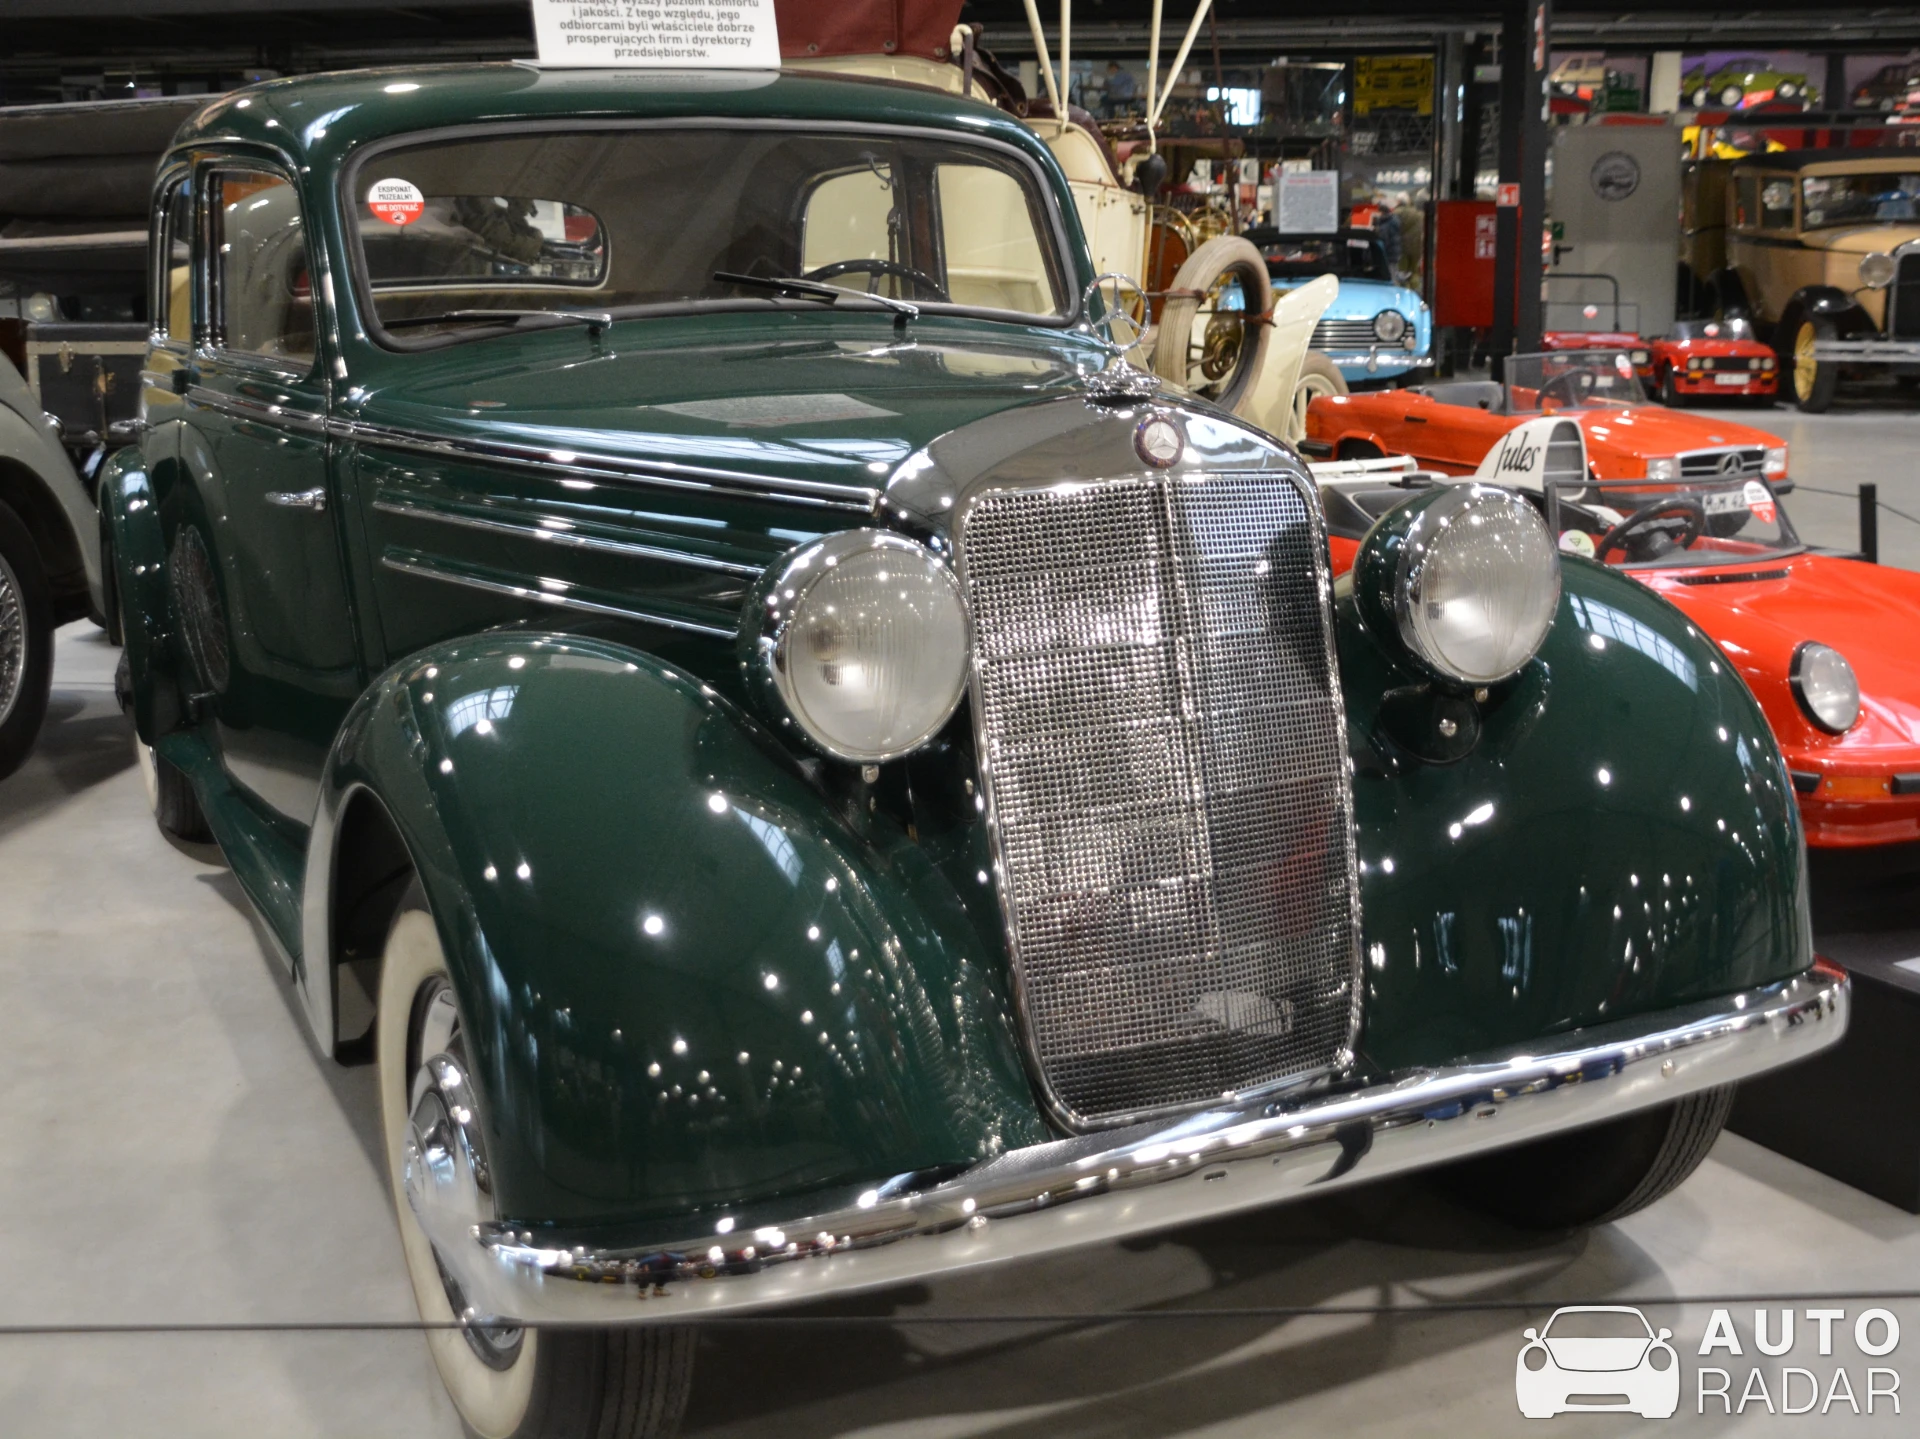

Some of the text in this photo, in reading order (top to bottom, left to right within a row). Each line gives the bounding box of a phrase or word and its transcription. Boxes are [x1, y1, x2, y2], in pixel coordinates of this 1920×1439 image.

[578, 6, 624, 19] jakości.
[625, 7, 633, 17] Z
[636, 8, 661, 20] tego
[664, 9, 714, 20] względu,
[716, 9, 740, 21] jego
[560, 20, 625, 30] odbiorcami
[628, 21, 649, 32] byli
[717, 22, 755, 33] dobrze
[566, 33, 656, 46] prosperujących
[658, 34, 683, 44] firm
[691, 35, 752, 47] dyrektorzy
[614, 47, 710, 59] przedsiębiorstw.
[376, 202, 419, 212] NIE DOTYKAĆ
[1493, 431, 1541, 479] Jules
